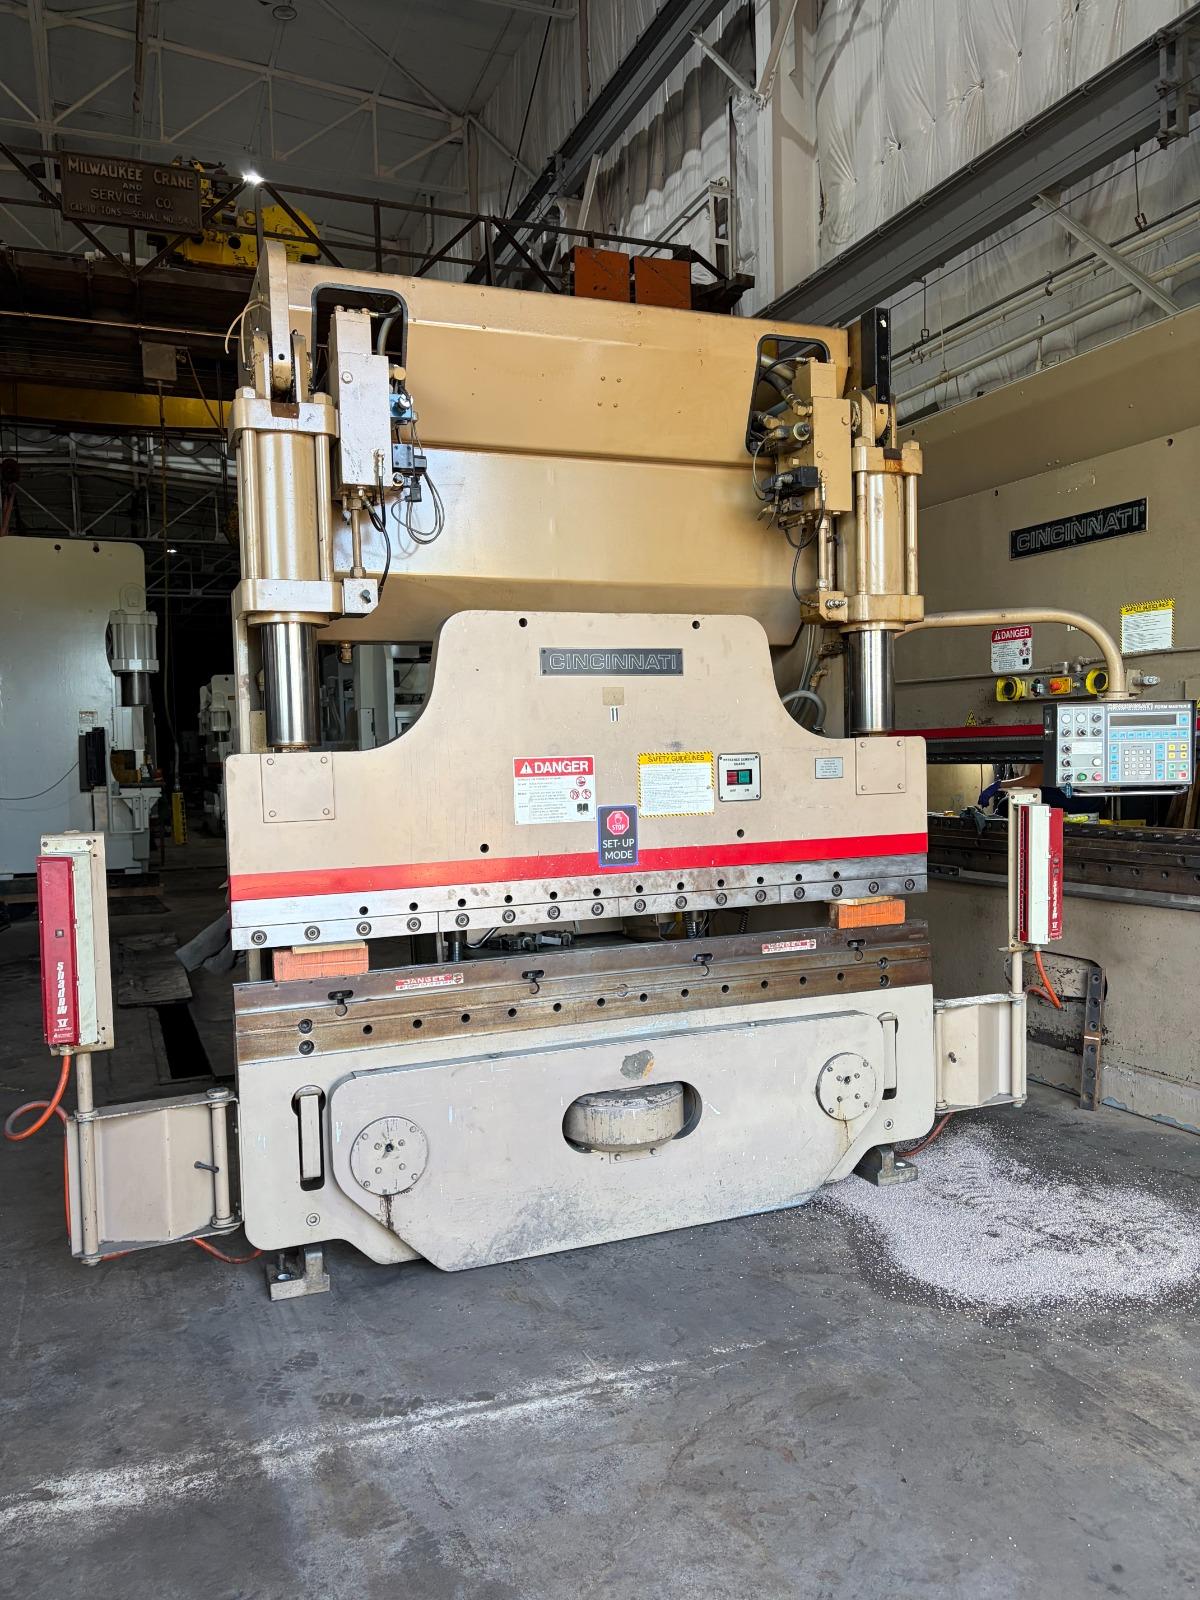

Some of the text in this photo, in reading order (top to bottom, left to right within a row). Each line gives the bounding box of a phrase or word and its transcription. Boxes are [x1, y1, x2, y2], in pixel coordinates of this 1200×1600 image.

[67, 157, 194, 189] MILWAUKEE CRANE
[122, 182, 143, 191] AND
[90, 188, 174, 210] SERVICE CO.
[132, 209, 160, 222] SERIAL
[1016, 506, 1139, 552] CINCINNATI
[1001, 628, 1030, 640] DANGER
[550, 653, 677, 670] CINCINNATI
[647, 754, 705, 763] SAFETY GUIDELINES
[534, 760, 589, 774] DANGER
[605, 850, 633, 860] MODE
